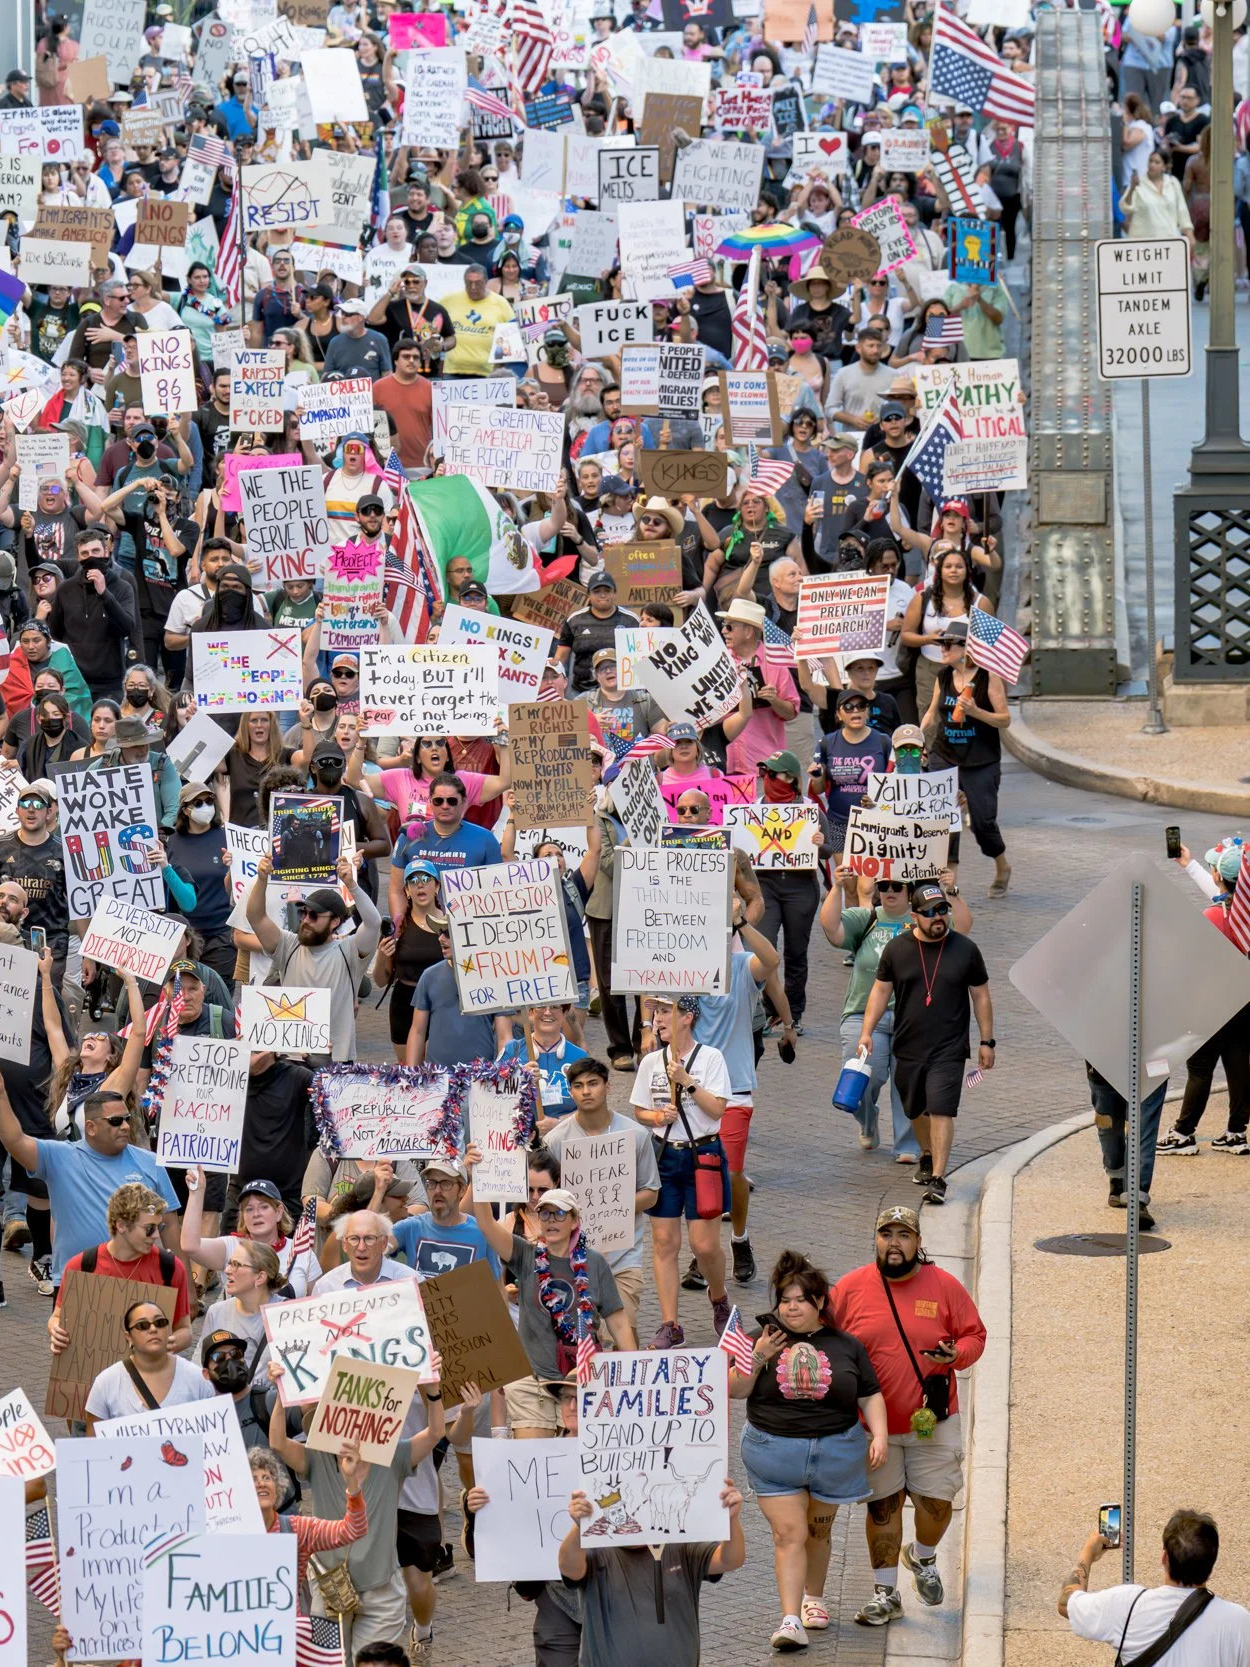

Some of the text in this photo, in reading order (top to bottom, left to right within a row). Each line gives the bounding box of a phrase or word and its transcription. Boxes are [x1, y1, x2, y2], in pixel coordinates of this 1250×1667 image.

[5, 156, 21, 170] IS
[610, 155, 654, 179] ICE
[37, 208, 112, 230] IMMIGRANTS
[150, 204, 174, 221] NO
[247, 200, 320, 227] RESIST
[61, 228, 108, 243] AMERICA
[138, 223, 185, 244] KINGS
[1114, 248, 1170, 262] WEIGHT
[1123, 273, 1163, 286] LIMIT
[595, 307, 648, 322] FUCK
[1118, 298, 1171, 312] TANDEM
[598, 328, 635, 343] ICE
[1128, 322, 1161, 335] AXLE
[151, 338, 179, 354] NO
[1105, 347, 1185, 364] 32000 LBS
[140, 352, 191, 373] KINGS
[235, 352, 267, 364] VOTE
[241, 367, 283, 380] RAPIST
[159, 380, 181, 396] 86
[234, 381, 283, 397] EXPECT
[158, 396, 181, 411] 47
[489, 410, 563, 434] GREATNESS
[473, 429, 532, 447] AMERICA
[476, 447, 520, 469] RIGHT
[516, 470, 559, 490] RIGHTS
[661, 463, 721, 481] KINGS
[242, 472, 312, 499] WE THE
[252, 501, 317, 522] PEOPLE
[249, 520, 329, 553] SERVE NO
[266, 557, 316, 580] KING
[811, 586, 877, 603] ONLY WE CAN
[819, 605, 865, 618] PREVENT
[460, 619, 481, 634] NO
[811, 620, 871, 635] OLIGARCHY
[422, 668, 454, 684] BUT
[364, 692, 414, 705] never
[418, 691, 474, 706] forget
[399, 709, 417, 721] of
[423, 709, 447, 722] not
[451, 710, 491, 727] being
[530, 720, 574, 733] RIGHTS
[514, 747, 591, 762] REPRODUCTIVE
[61, 767, 142, 792] HATE
[62, 786, 143, 815] WON'T
[64, 807, 145, 833] MAKE
[851, 808, 909, 839] Immigrants
[762, 828, 792, 840] AND
[65, 825, 158, 881] US
[851, 841, 927, 860] Dignity
[623, 852, 726, 872] DUE PROCESS
[850, 858, 946, 880] NOT detentio
[460, 887, 554, 916] PROTESTOR
[105, 901, 180, 941] DIVERSITY
[645, 909, 707, 926] BETWEEN
[483, 917, 558, 944] DESPISE
[626, 930, 708, 950] FREEDOM
[84, 934, 166, 977] DICTATORSHIP
[475, 948, 554, 978] FRUMP
[507, 970, 569, 1003] FREE!
[250, 1023, 330, 1049] NO KINGS
[188, 1044, 239, 1066] STOP
[170, 1063, 247, 1090] PRETENDING
[174, 1100, 230, 1121] RACISM
[162, 1132, 238, 1166] PATRIOTISM
[565, 1138, 625, 1160] NO HATE
[564, 1162, 629, 1186] NO FEAR
[278, 1293, 399, 1328] PRESIDENTS
[587, 1356, 710, 1388] MILITARY
[333, 1372, 385, 1407] TANKS
[583, 1385, 716, 1417] FAMILIES
[319, 1405, 402, 1443] NOTHING!
[583, 1420, 715, 1449] STAND UP TO
[168, 1553, 293, 1610] FAMILIES
[153, 1620, 282, 1662] BELONG
